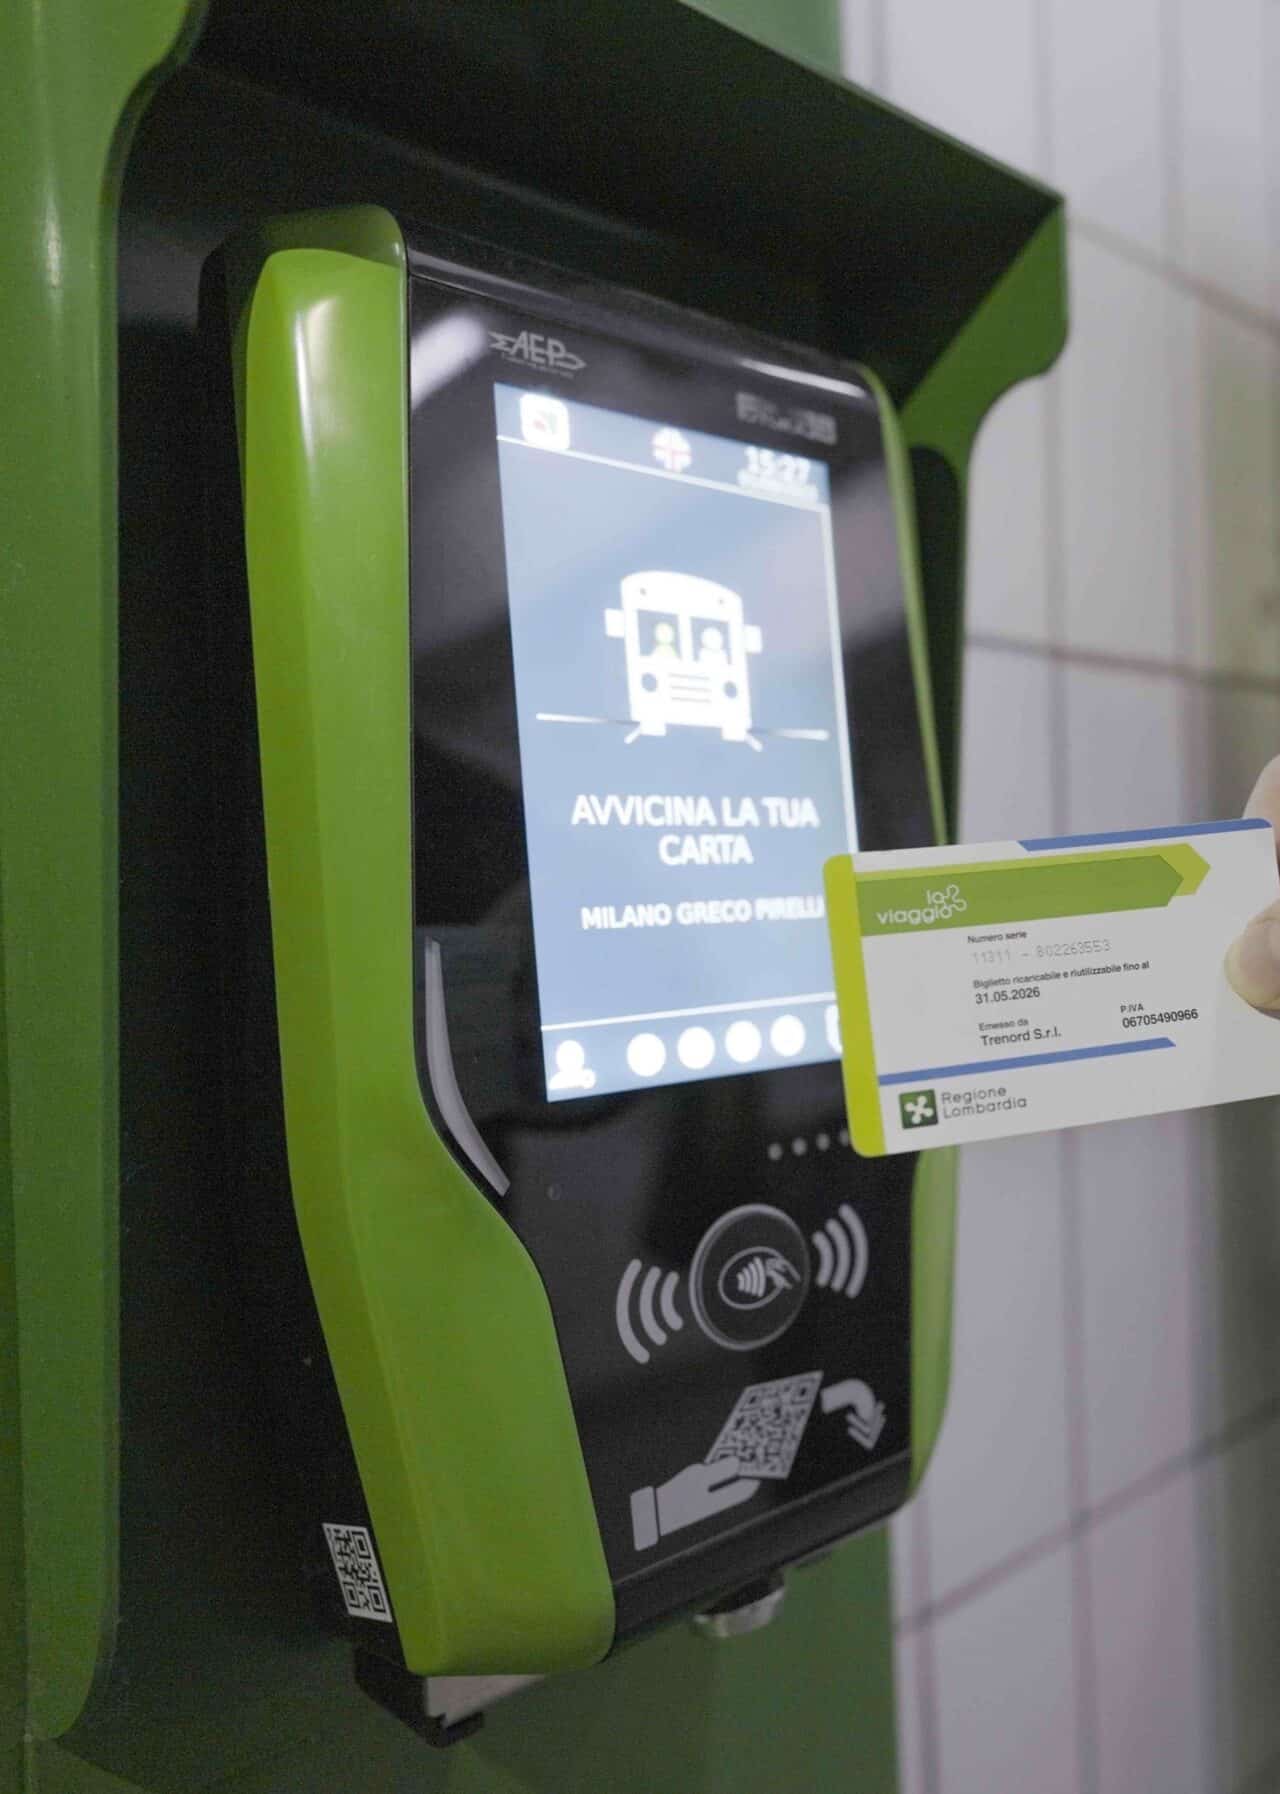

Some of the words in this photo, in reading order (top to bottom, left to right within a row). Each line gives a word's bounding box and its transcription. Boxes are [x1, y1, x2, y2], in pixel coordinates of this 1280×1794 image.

[510, 330, 567, 367] AEP
[570, 794, 717, 827] AVVICINA
[720, 796, 760, 828] LA
[761, 796, 821, 829] TUA
[657, 834, 755, 866] CARTA
[580, 903, 672, 930] MILANO
[675, 898, 751, 926] GRECO
[876, 903, 953, 926] viaggio
[967, 932, 1004, 944] Numero
[1004, 930, 1028, 941] serie
[972, 977, 1012, 990] Biglietto
[1012, 970, 1062, 985] ricaricabile
[1070, 963, 1122, 978] riutilizzabile
[1122, 961, 1141, 971] fino
[1141, 960, 1150, 970] al
[975, 986, 1041, 1005] 31.05.2026
[978, 1019, 1016, 1032] Emesso
[1017, 1017, 1030, 1027] da
[1121, 1008, 1199, 1029] 06705490966
[980, 1028, 1031, 1048] Trenord
[1032, 1025, 1063, 1041] S.r.l.
[941, 1086, 1008, 1105] Regione
[942, 1096, 1028, 1120] Lombardia
